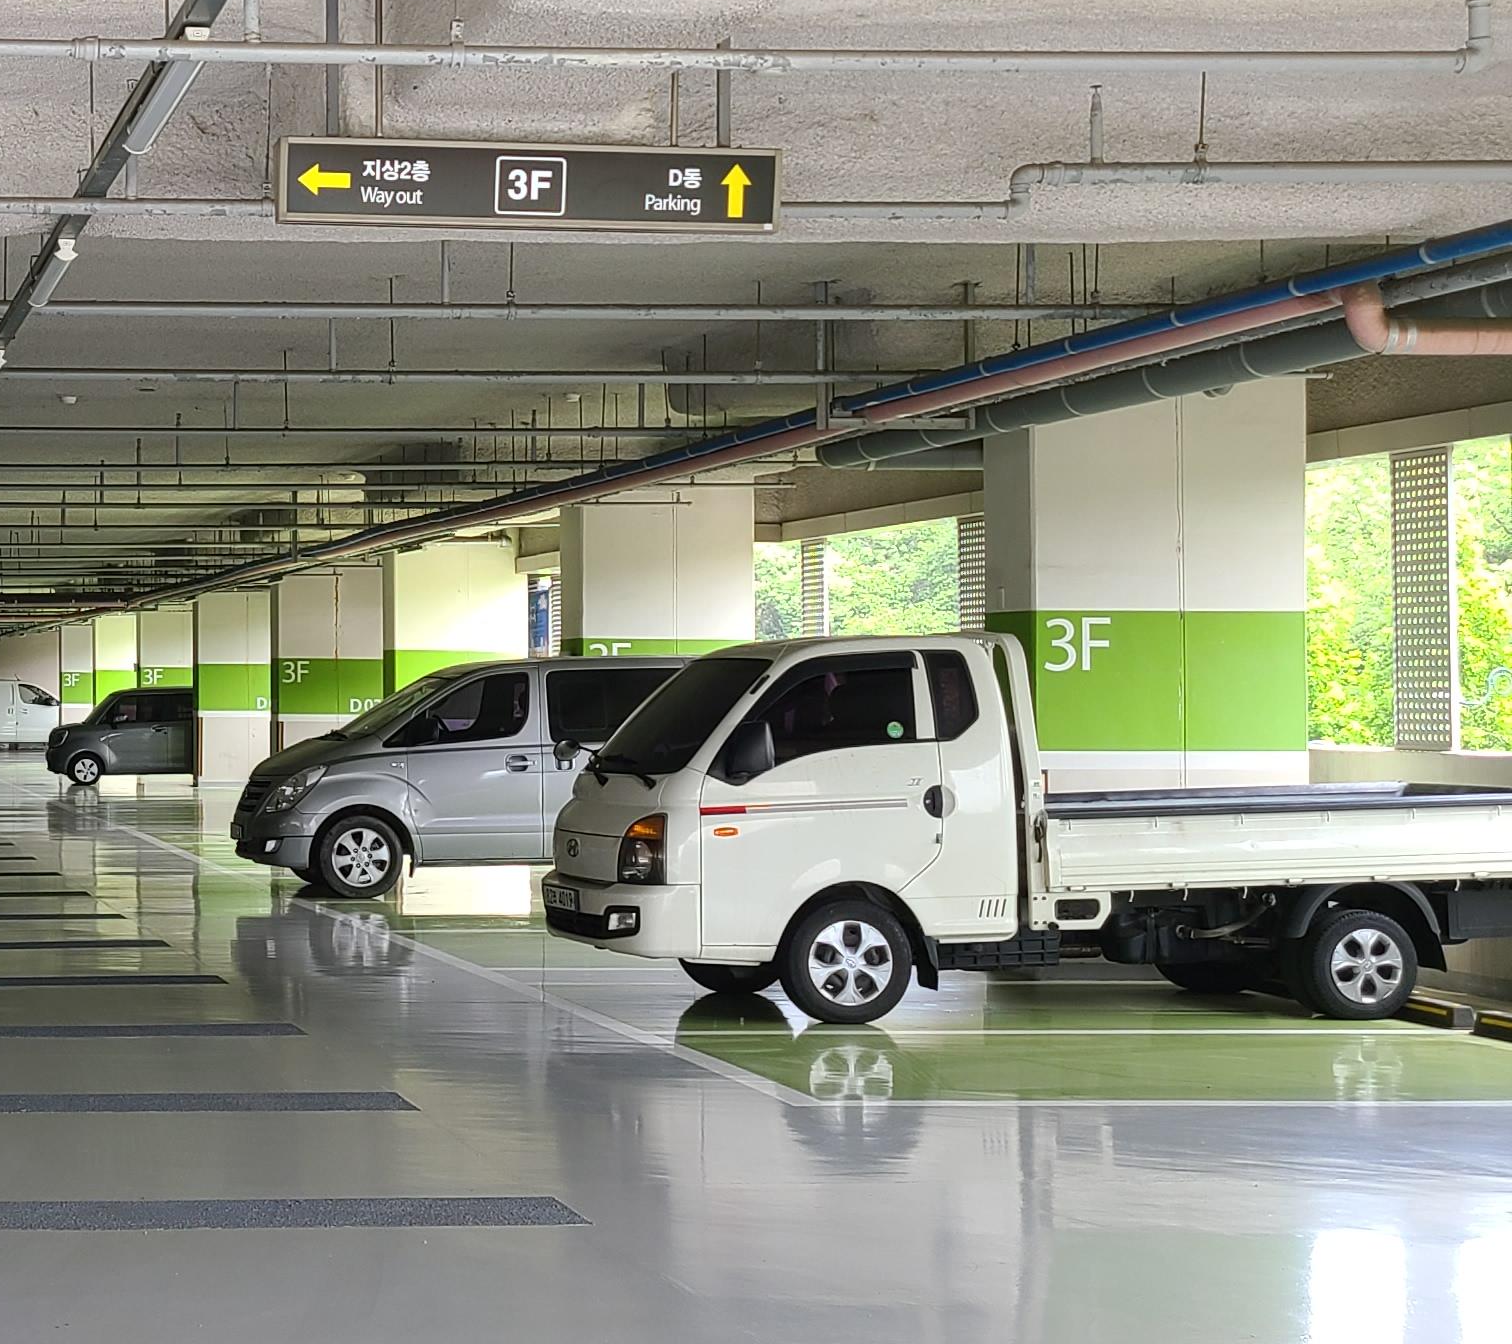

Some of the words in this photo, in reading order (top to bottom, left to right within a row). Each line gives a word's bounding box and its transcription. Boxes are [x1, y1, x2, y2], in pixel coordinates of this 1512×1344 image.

[362, 159, 431, 182] 지상2층
[668, 168, 703, 189] D동
[507, 169, 553, 201] 3F
[360, 186, 394, 208] Way
[395, 190, 423, 205] out
[644, 193, 702, 216] Parking
[1044, 616, 1112, 672] 3F
[63, 673, 80, 687] 3F
[142, 668, 164, 685] 3F
[282, 660, 310, 684] 3F
